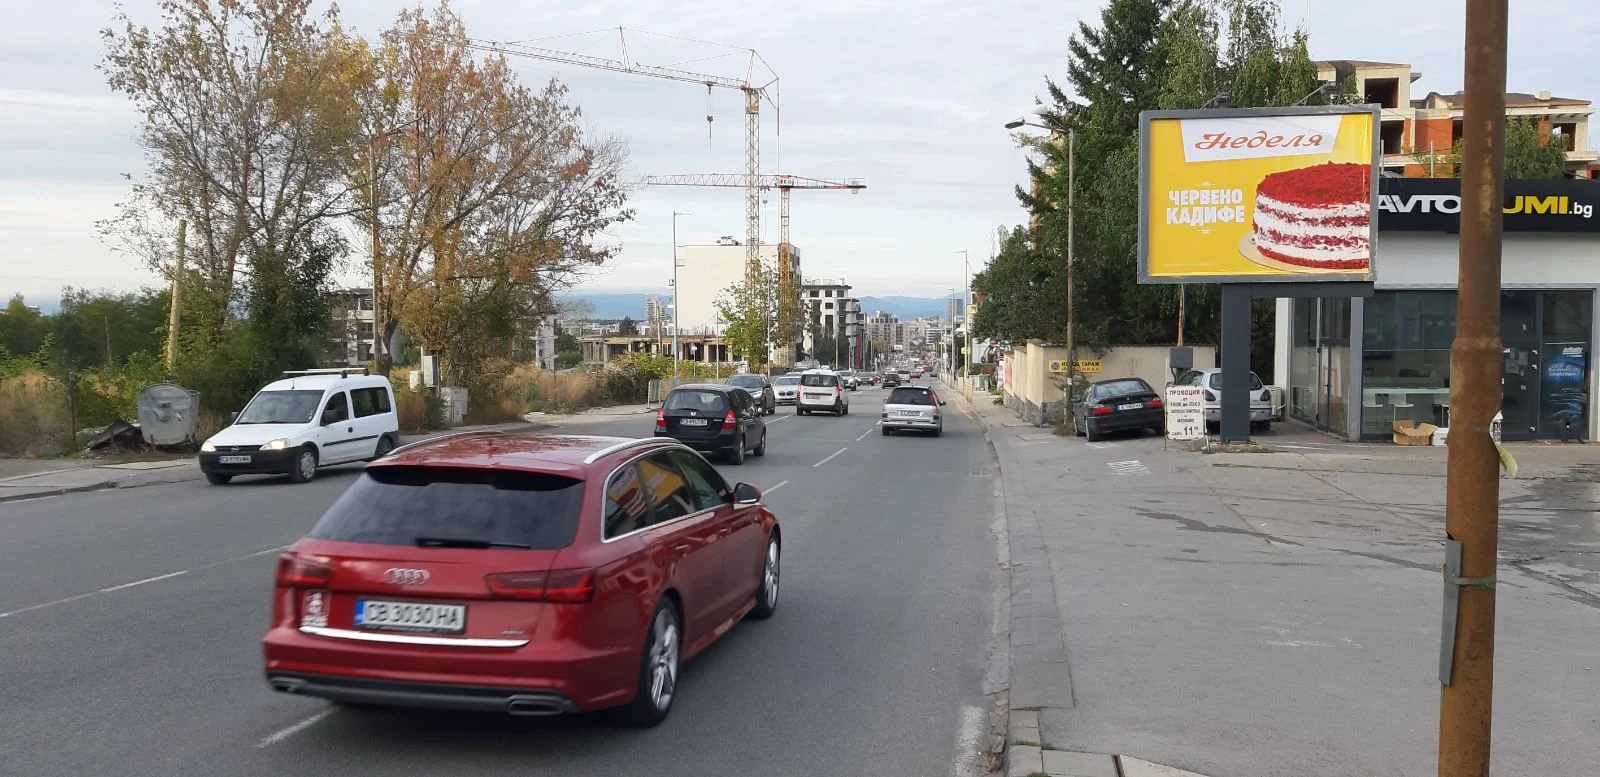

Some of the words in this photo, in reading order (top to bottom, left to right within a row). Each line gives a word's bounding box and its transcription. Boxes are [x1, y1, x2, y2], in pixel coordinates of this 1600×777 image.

[1194, 130, 1323, 150] Неделя
[1168, 188, 1243, 206] ЧЕРВЕНО
[1166, 205, 1245, 227] КАДИФЕ
[1169, 389, 1201, 397] ПРОМОЦИЯ
[391, 605, 434, 625] 3030
